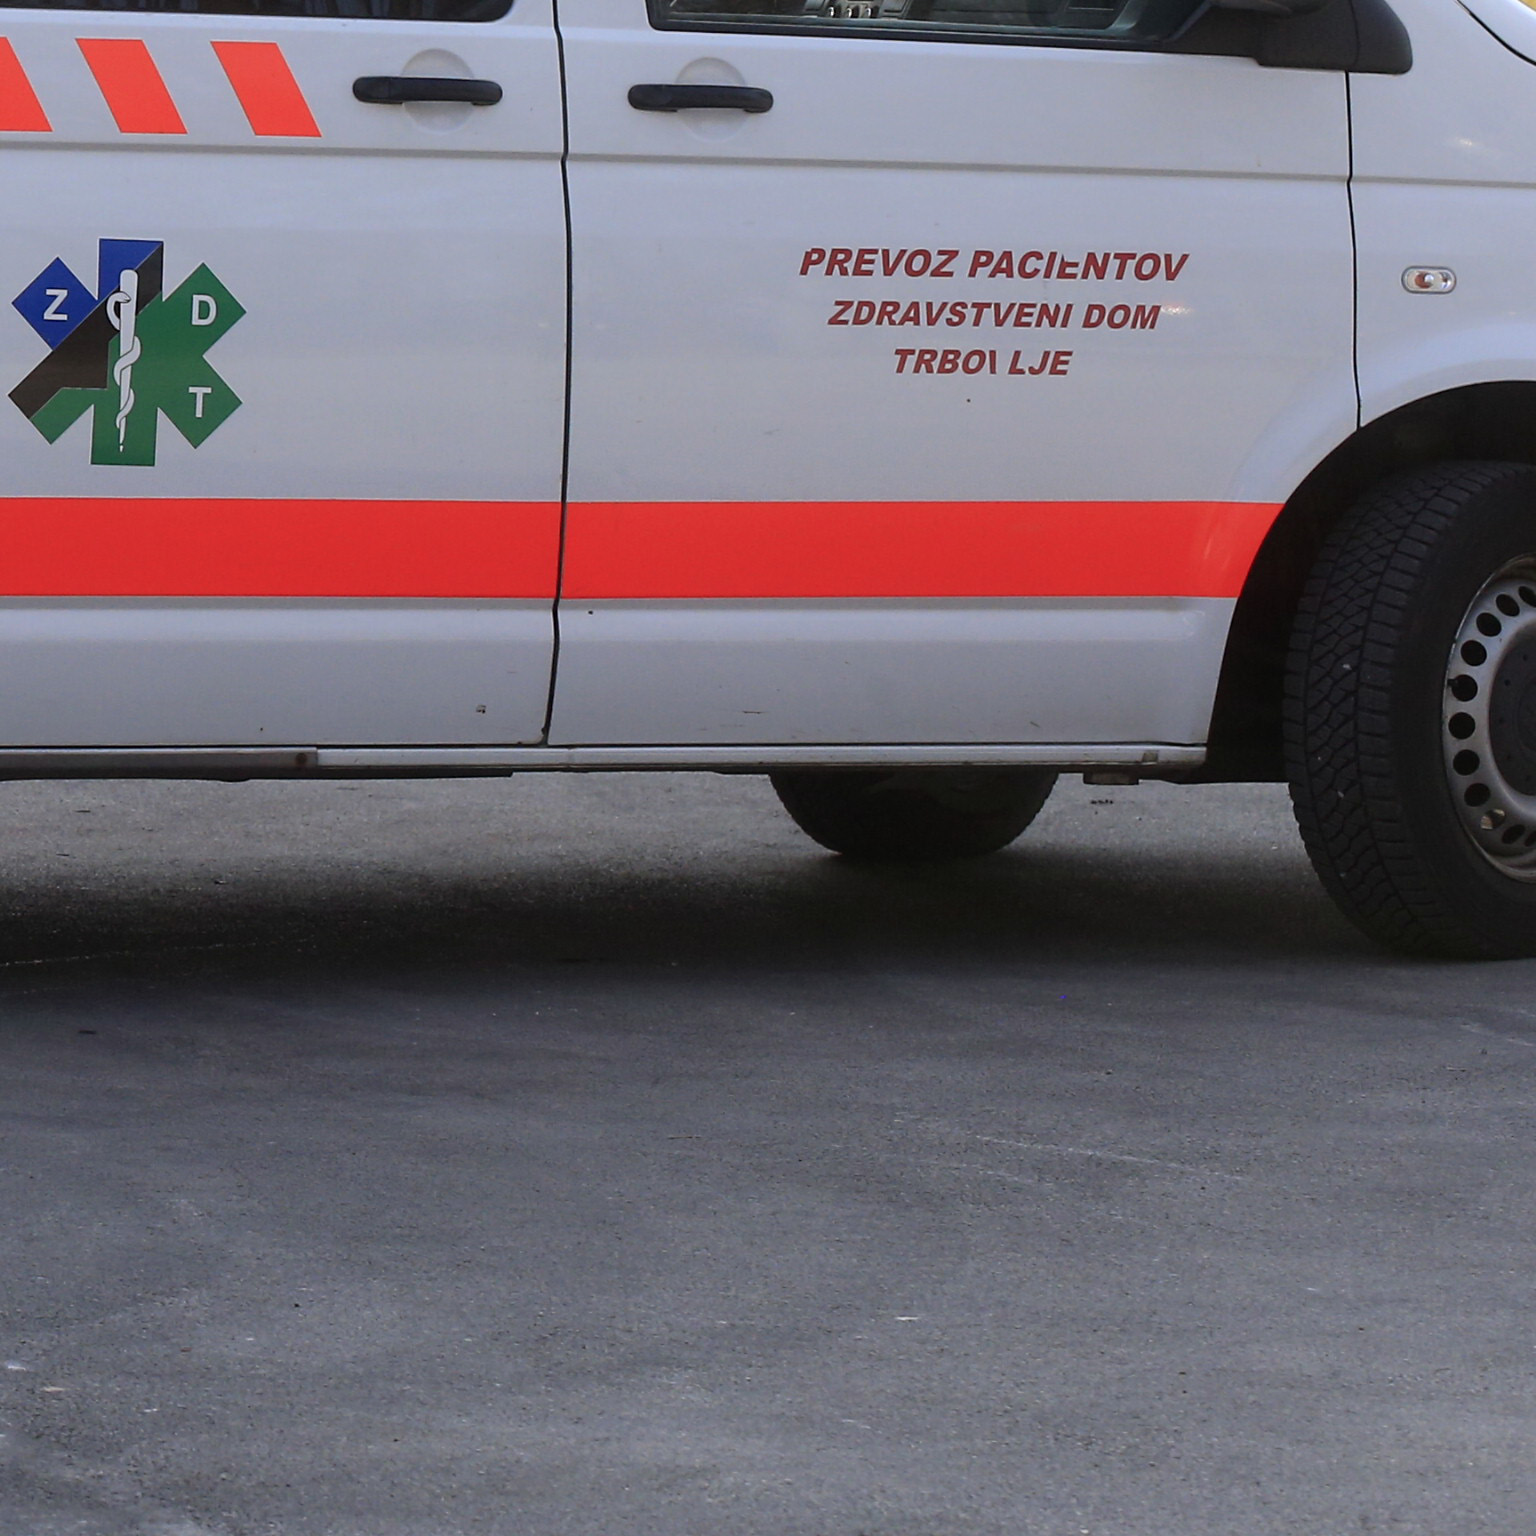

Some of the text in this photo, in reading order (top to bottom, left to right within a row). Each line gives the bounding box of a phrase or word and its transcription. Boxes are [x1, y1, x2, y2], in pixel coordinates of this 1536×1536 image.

[799, 248, 1189, 282] PREVOZ PACIENTOV
[43, 289, 218, 326] Z D
[826, 299, 1162, 330] ZDRAVSTVENI DOM
[188, 386, 213, 418] T
